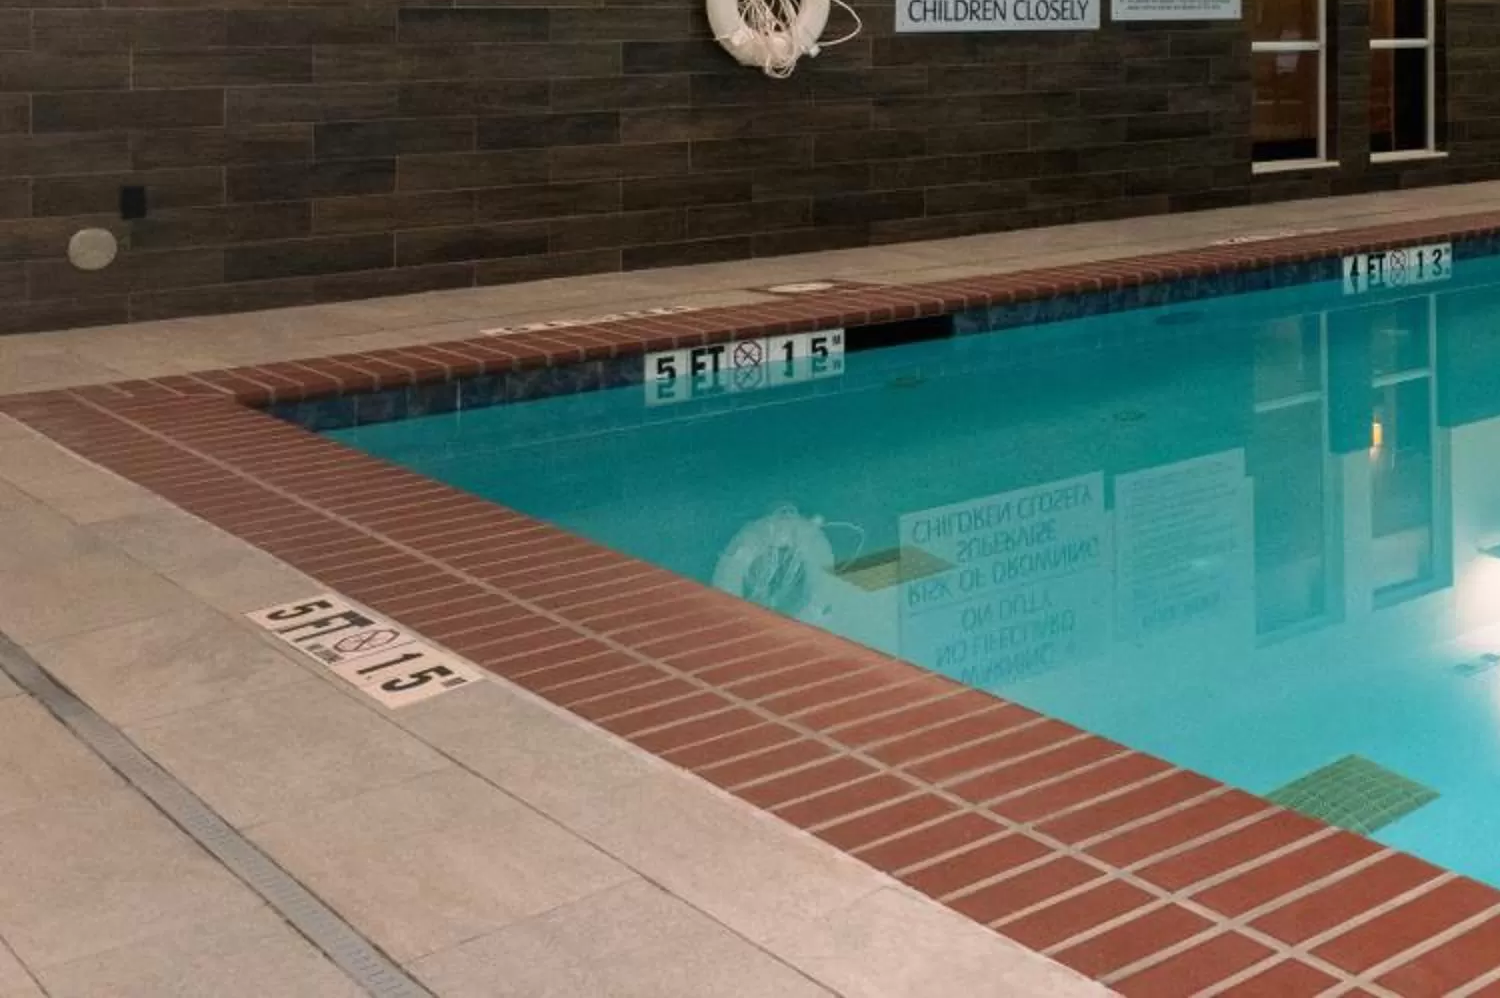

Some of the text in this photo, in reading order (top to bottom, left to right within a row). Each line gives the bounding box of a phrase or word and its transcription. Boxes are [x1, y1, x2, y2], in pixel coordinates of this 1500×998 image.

[908, 0, 1089, 22] CHILDREN CLOSELY
[1367, 252, 1386, 275] FT
[656, 355, 676, 380] 5
[691, 345, 725, 377] FT
[266, 600, 333, 620] 5
[278, 610, 376, 642] FT
